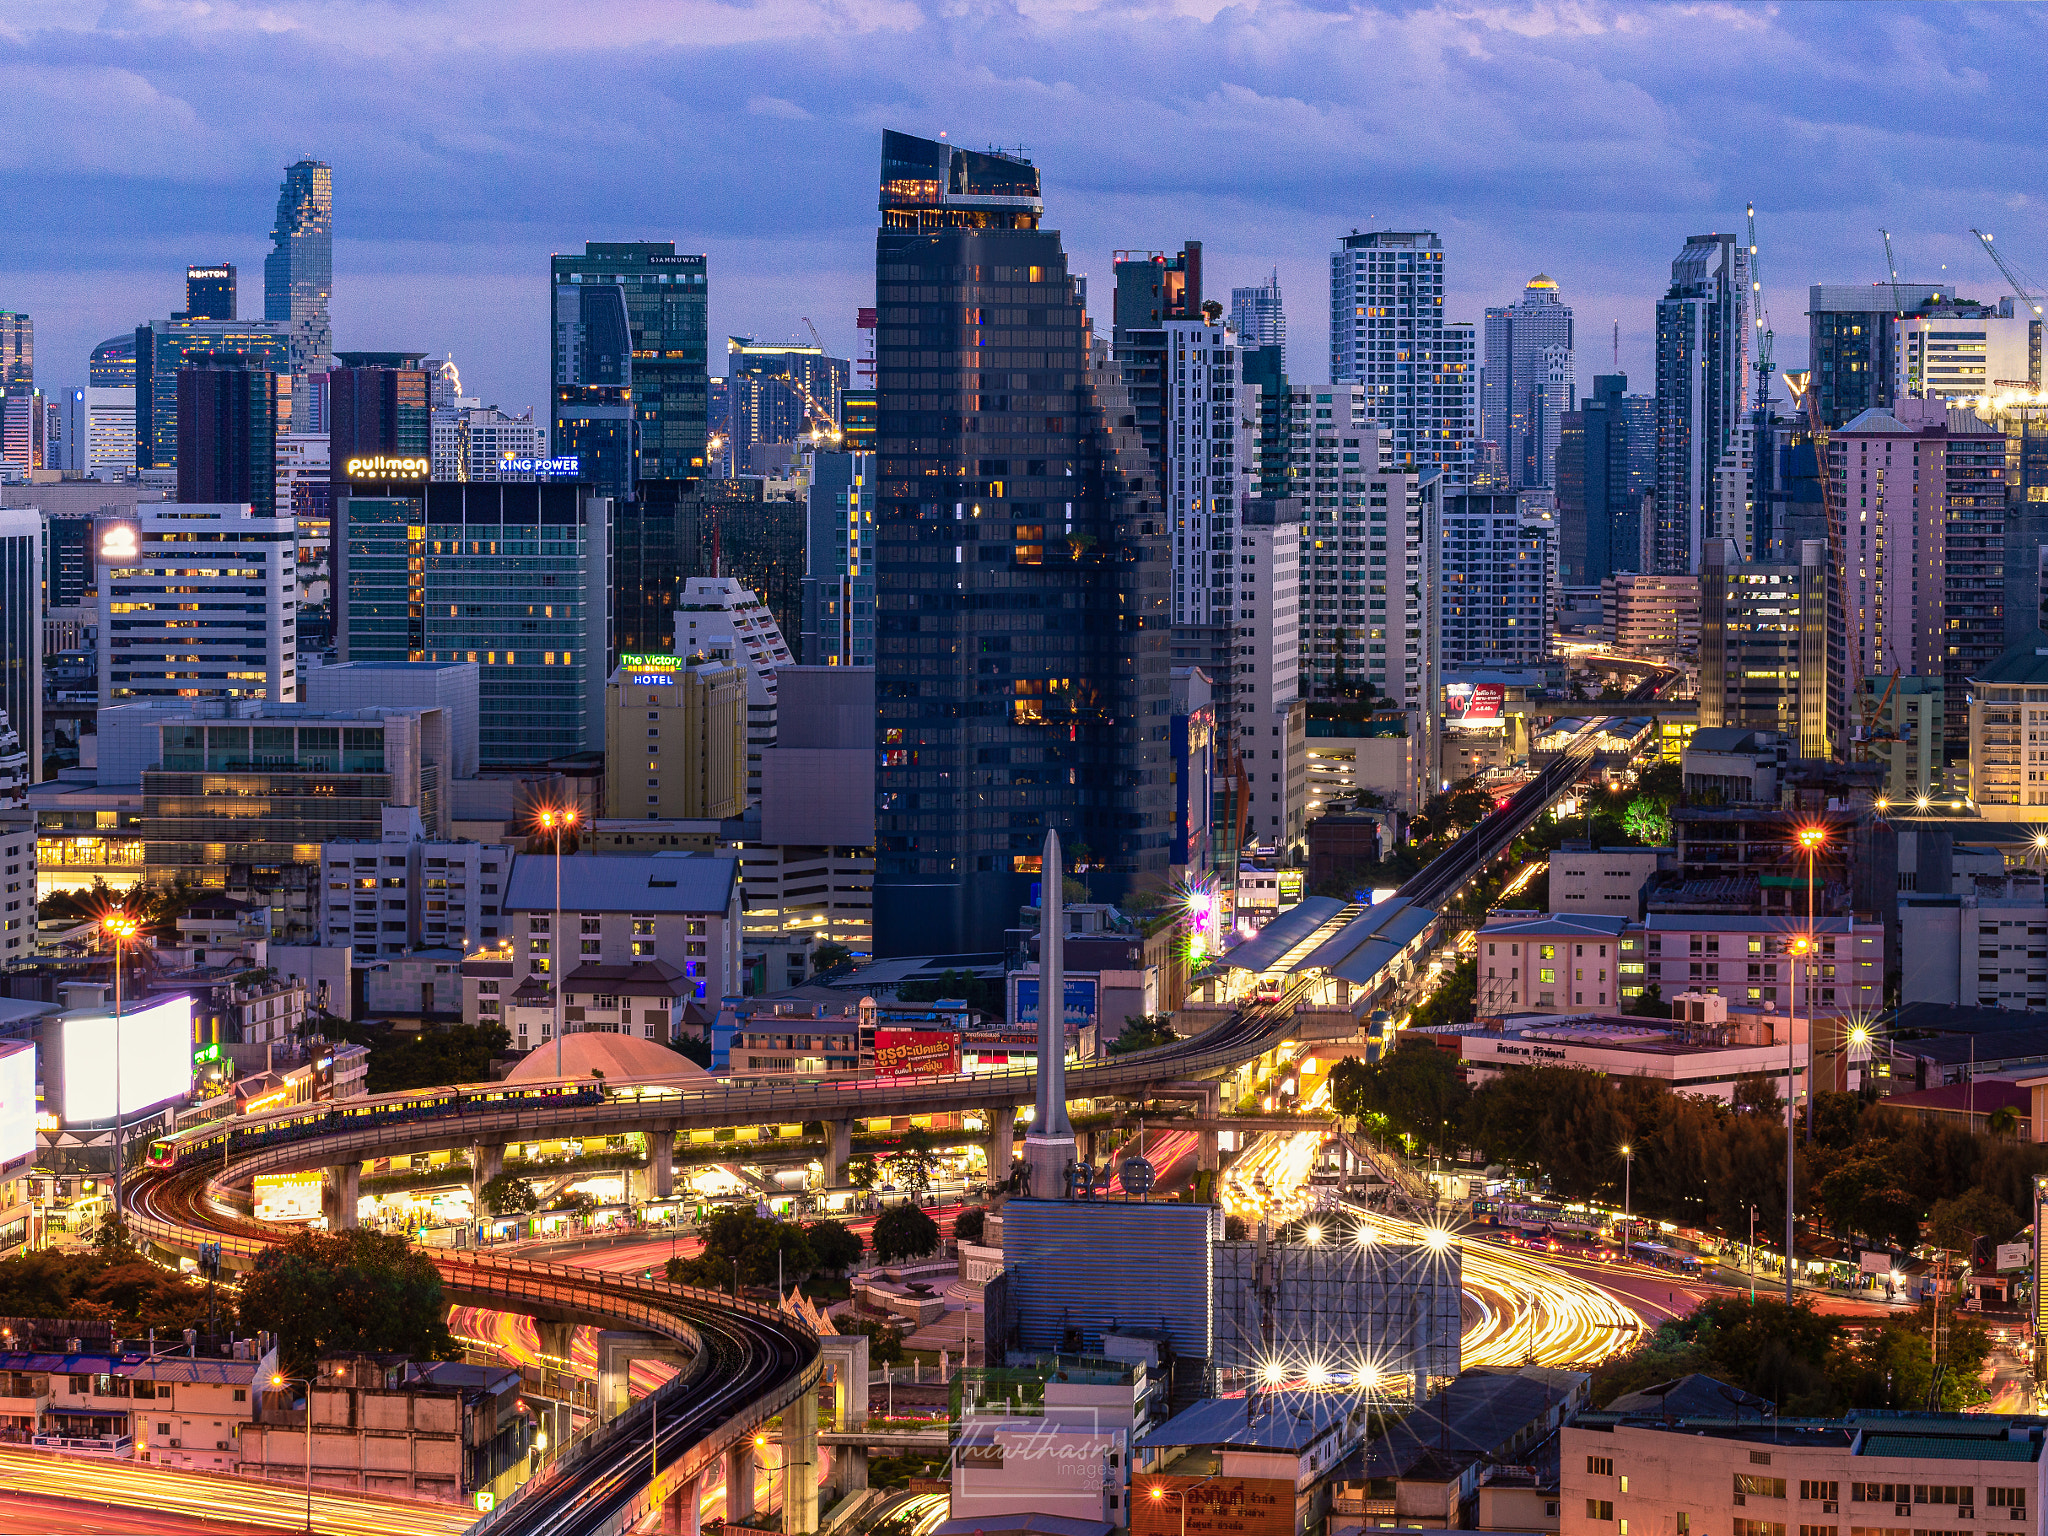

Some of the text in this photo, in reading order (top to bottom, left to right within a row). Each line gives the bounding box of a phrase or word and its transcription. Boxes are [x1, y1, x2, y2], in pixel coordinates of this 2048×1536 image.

[189, 270, 228, 278] ASHTON
[348, 455, 429, 475] pullman
[500, 459, 579, 471] KING POWER
[621, 655, 682, 667] The Victory
[634, 675, 674, 685] HOTEL
[1447, 695, 1465, 711] 10
